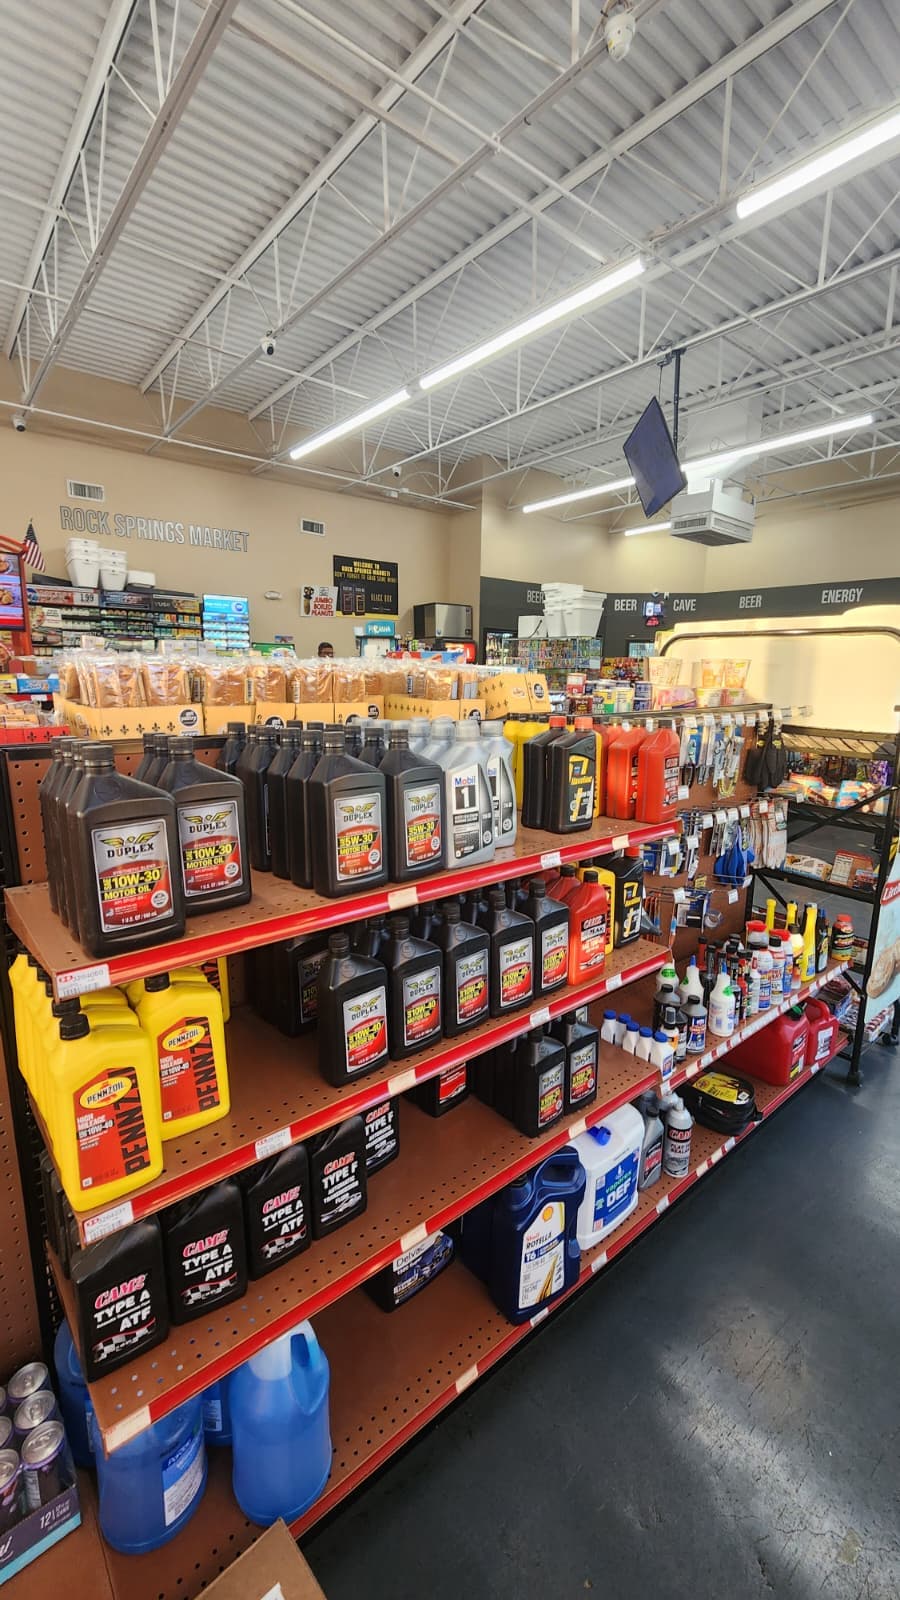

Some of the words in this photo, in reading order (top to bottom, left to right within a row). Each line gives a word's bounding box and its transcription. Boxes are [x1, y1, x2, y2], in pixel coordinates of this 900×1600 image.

[60, 506, 111, 535] ROCK
[114, 514, 185, 544] SPRINGS
[189, 525, 249, 552] MARKET
[527, 590, 545, 603] BEER
[614, 599, 637, 611] BEER
[673, 599, 697, 611] CAVE
[739, 595, 762, 609] BEER
[821, 588, 863, 604] ENERGY
[455, 776, 476, 785] Mobil
[461, 787, 469, 809] 1
[344, 812, 373, 823] DUPLEX
[189, 821, 228, 833] DUPLEX
[415, 821, 436, 834] 5W-30
[346, 833, 374, 847] 5W-30
[107, 842, 155, 859] DUPLEX
[193, 843, 232, 861] 10W-30
[187, 860, 212, 870] MOTOR
[214, 857, 225, 865] OIL
[112, 868, 161, 888] 10W-30
[104, 887, 137, 901] MOTOR
[138, 885, 152, 893] OIL
[410, 983, 433, 998] DUPLEX
[352, 1005, 378, 1020] DUPLEX
[168, 1028, 199, 1048] PENNZOIL
[87, 1081, 124, 1105] PENNZOIL
[365, 1115, 387, 1136] TYPE
[388, 1111, 394, 1123] F
[322, 1166, 349, 1189] TYPE
[352, 1161, 358, 1173] F
[607, 1178, 631, 1207] DEF
[262, 1204, 293, 1226] TYPE
[296, 1200, 303, 1210] A
[281, 1214, 304, 1235] ATF
[526, 1231, 552, 1250] ROTELLA
[182, 1248, 219, 1270] TYPE
[223, 1244, 232, 1255] A
[526, 1252, 537, 1263] T6
[205, 1260, 233, 1281] ATF
[94, 1295, 135, 1322] TYPE
[140, 1289, 150, 1302] A
[120, 1306, 151, 1332] ATF
[40, 1511, 52, 1529] 12
